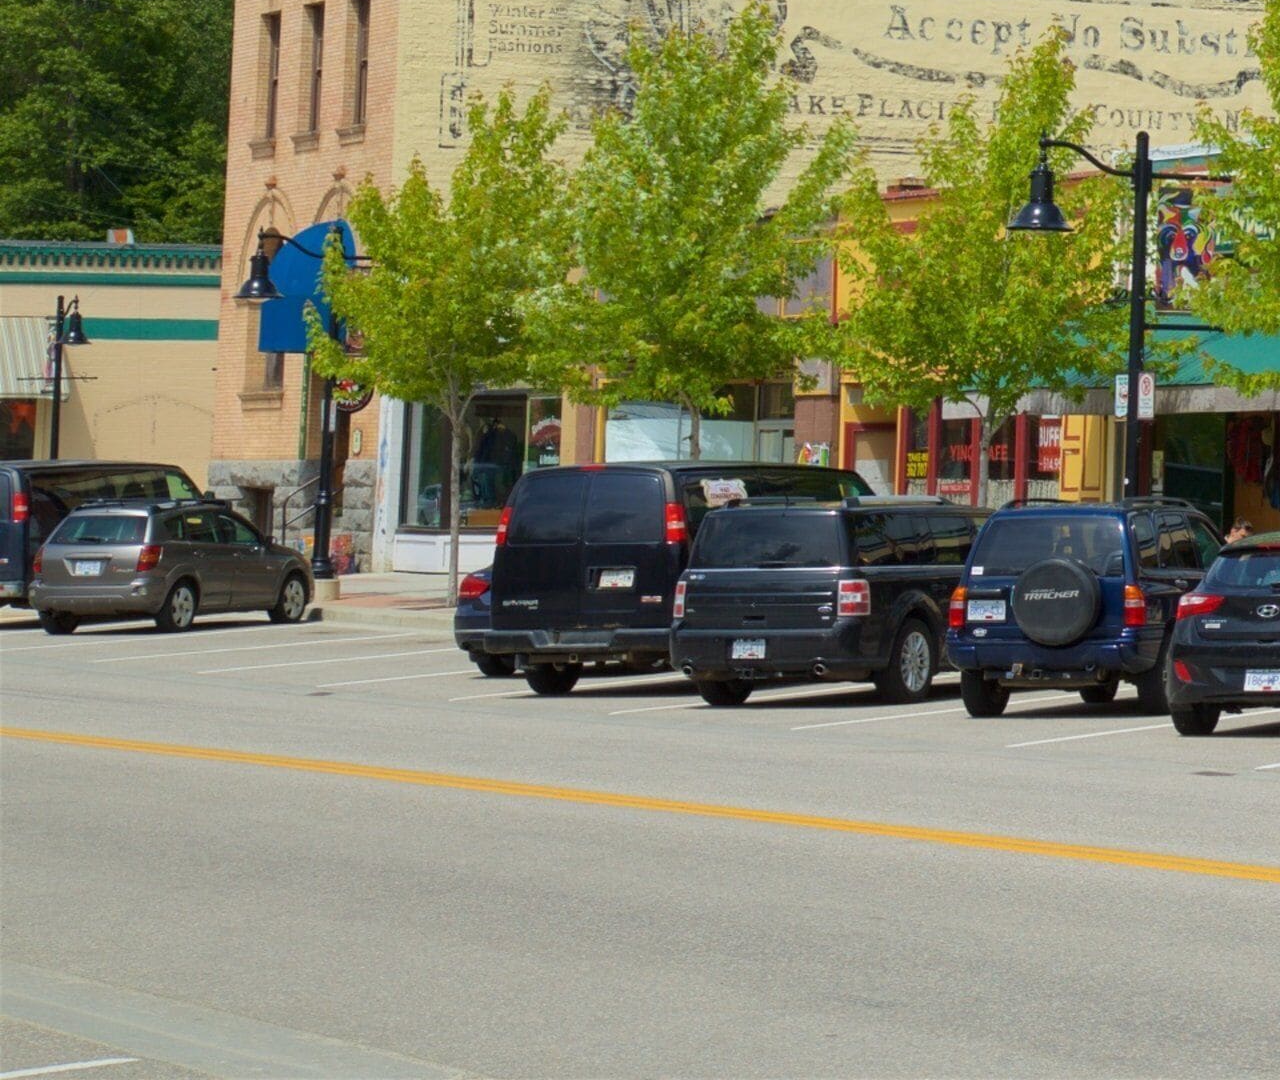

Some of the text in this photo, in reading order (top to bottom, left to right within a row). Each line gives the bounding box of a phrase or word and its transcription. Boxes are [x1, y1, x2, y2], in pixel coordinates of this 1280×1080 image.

[488, 3, 546, 19] Winter
[488, 20, 565, 38] Summer
[883, 4, 1033, 56] Accept
[1119, 16, 1257, 58] Subst
[488, 40, 563, 54] Fashions
[786, 92, 950, 120] AKE PLACI
[1039, 425, 1060, 447] BUFF
[990, 443, 1008, 462] AFE
[1024, 590, 1079, 601] TRACKER
